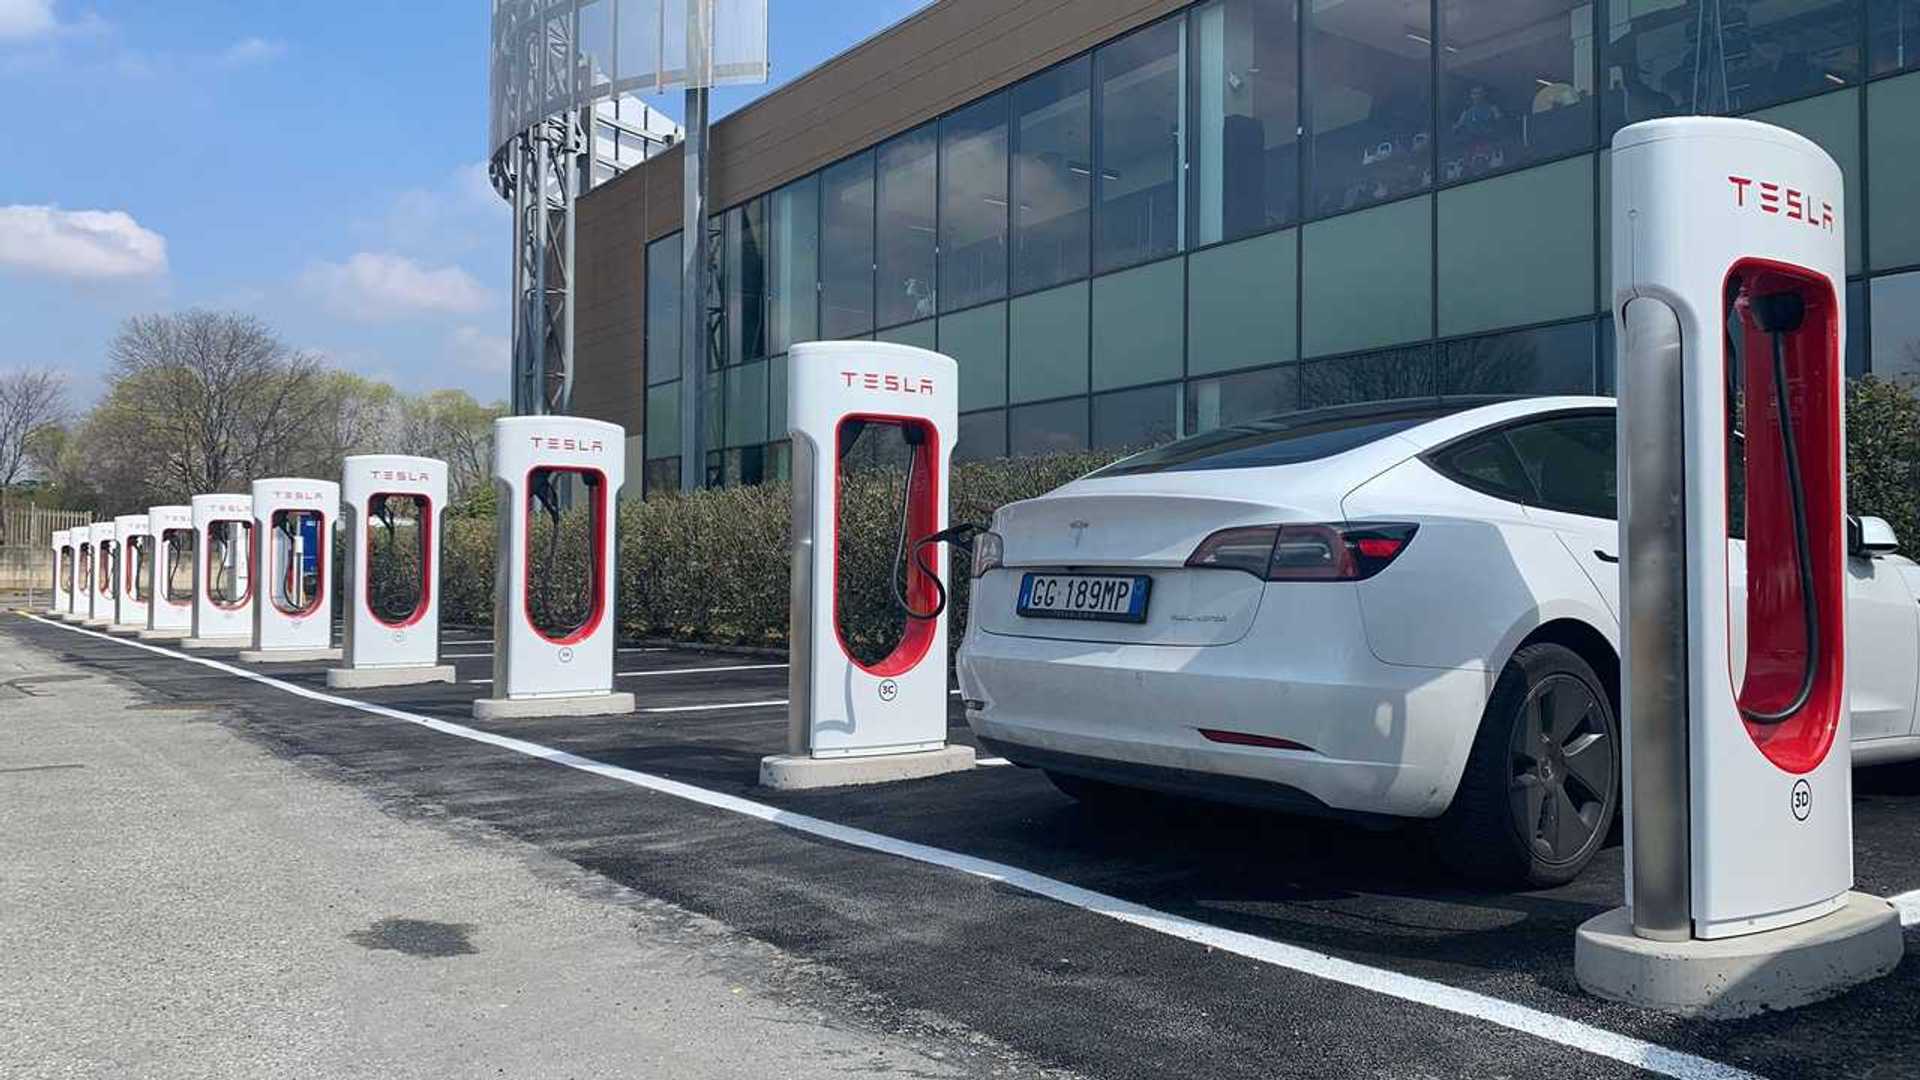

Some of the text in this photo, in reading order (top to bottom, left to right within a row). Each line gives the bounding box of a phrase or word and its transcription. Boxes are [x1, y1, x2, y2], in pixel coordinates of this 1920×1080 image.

[1728, 174, 1834, 232] TESLA
[841, 371, 933, 395] TESLA
[529, 436, 603, 453] TESLA
[369, 470, 430, 482] TESLA
[273, 490, 324, 500] TESLA
[1031, 578, 1130, 611] GG 189MP
[882, 685, 894, 695] 3C
[1795, 791, 1809, 808] 3D
